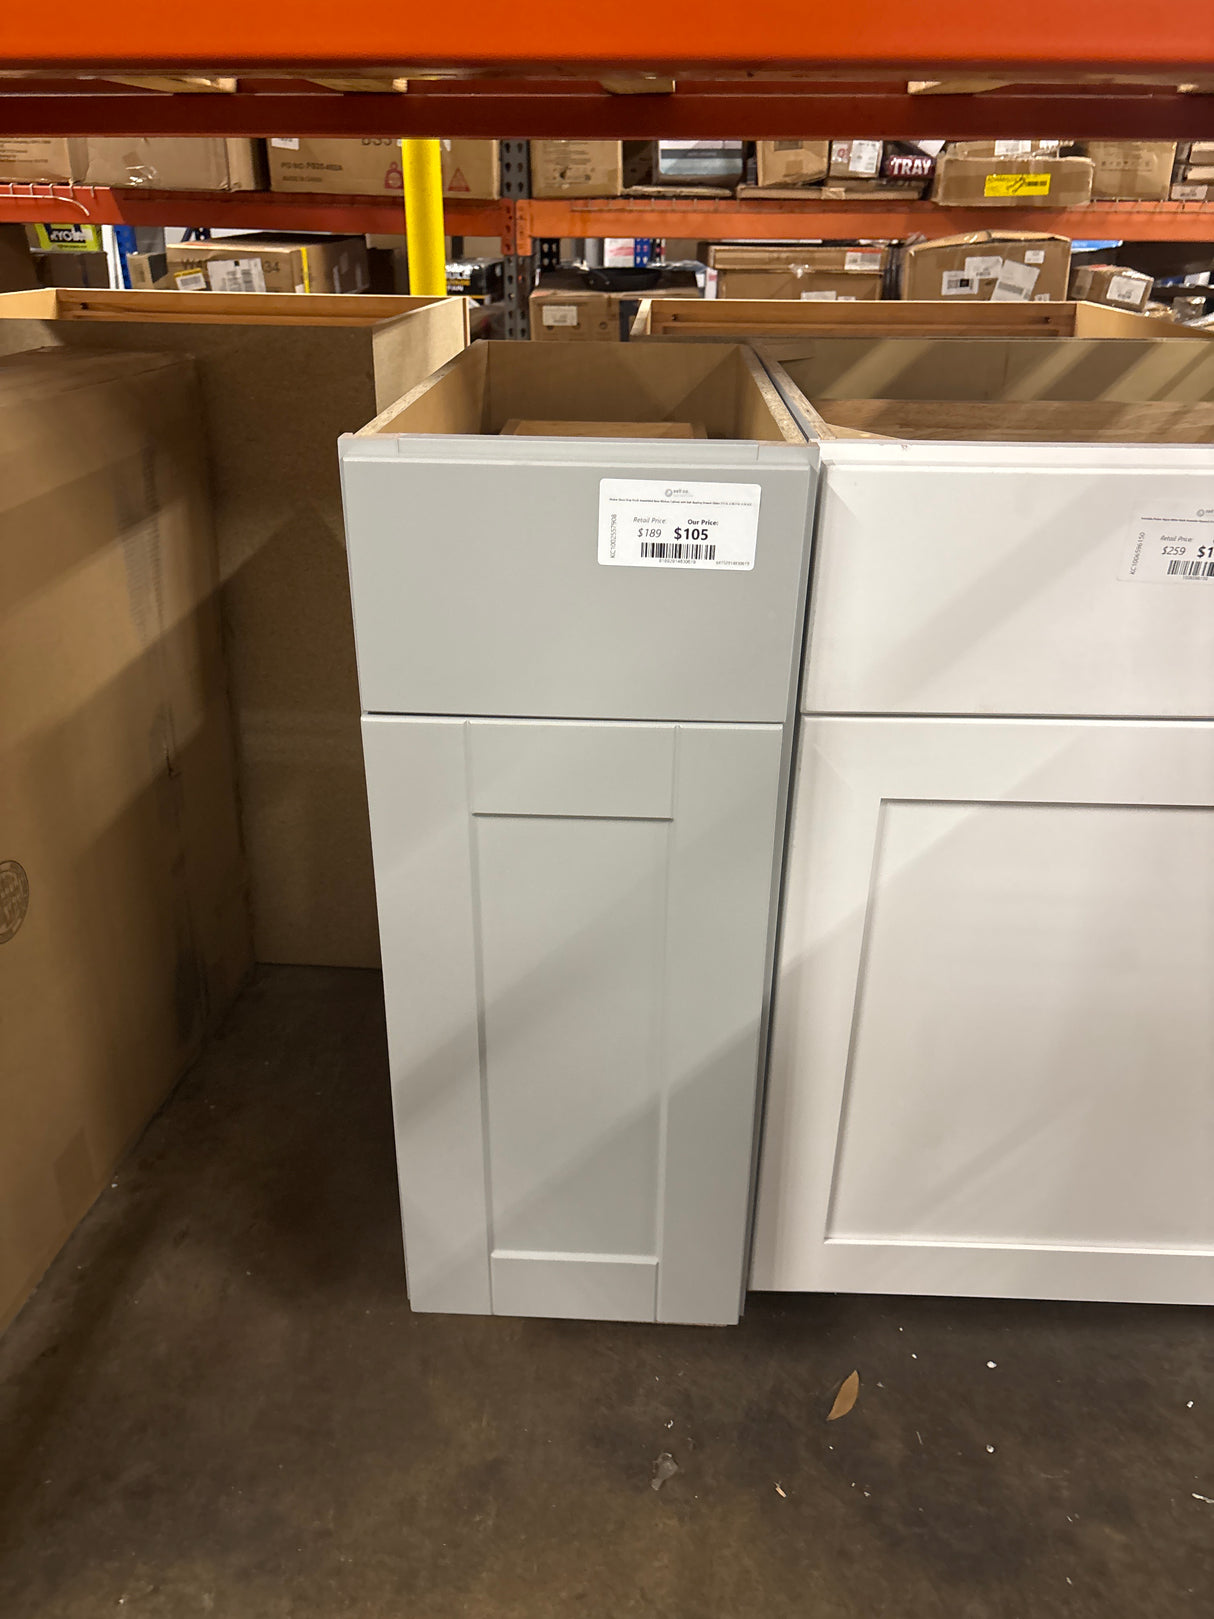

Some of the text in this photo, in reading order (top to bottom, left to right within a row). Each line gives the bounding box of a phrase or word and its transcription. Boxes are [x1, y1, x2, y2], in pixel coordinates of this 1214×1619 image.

[891, 157, 932, 175] TRAY
[633, 516, 650, 524] Retail
[637, 527, 662, 538] $189
[674, 526, 709, 541] $105
[1161, 545, 1187, 556] $259
[1197, 545, 1214, 559] $1
